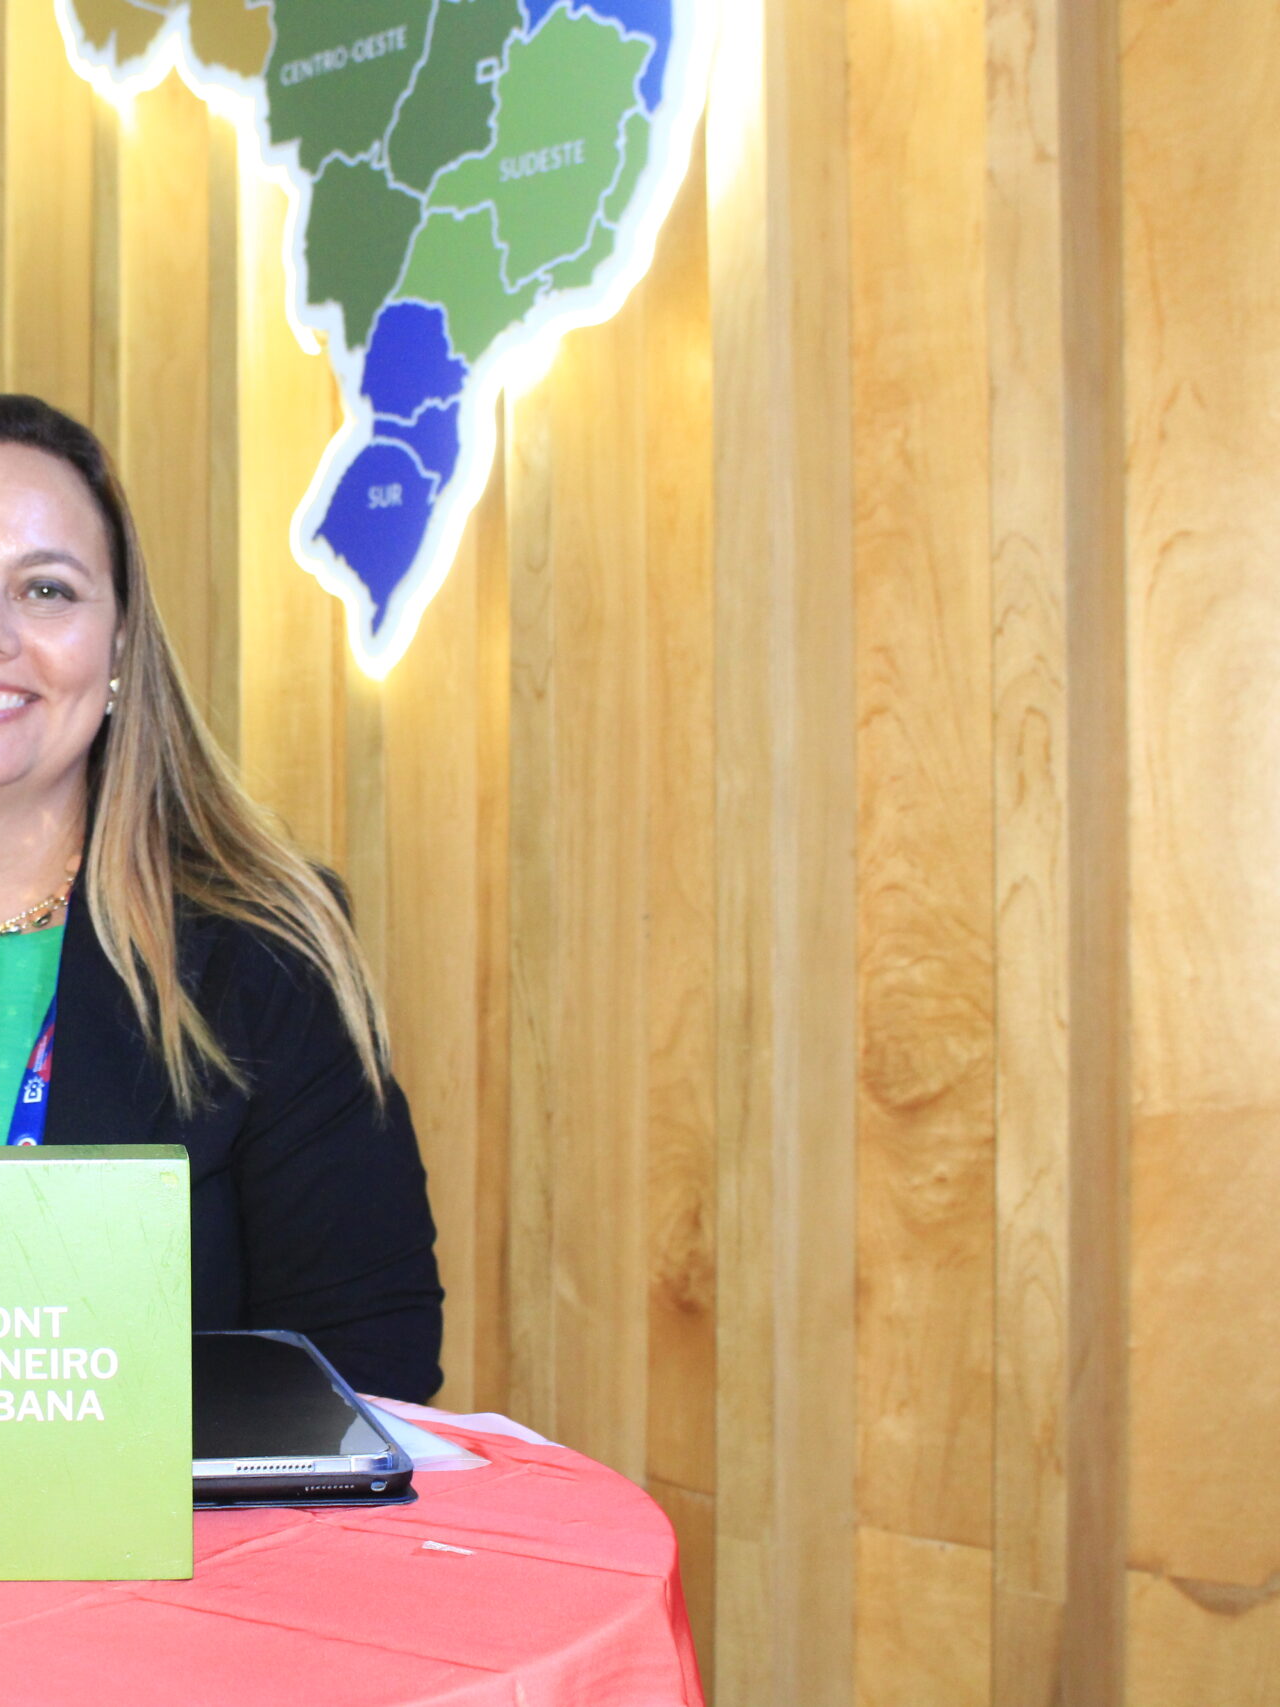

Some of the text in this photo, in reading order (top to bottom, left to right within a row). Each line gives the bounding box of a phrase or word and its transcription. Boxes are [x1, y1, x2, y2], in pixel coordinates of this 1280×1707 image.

[280, 24, 407, 86] CENTRO-OESTE
[499, 138, 585, 182] SUDESTE
[368, 484, 403, 509] SUR
